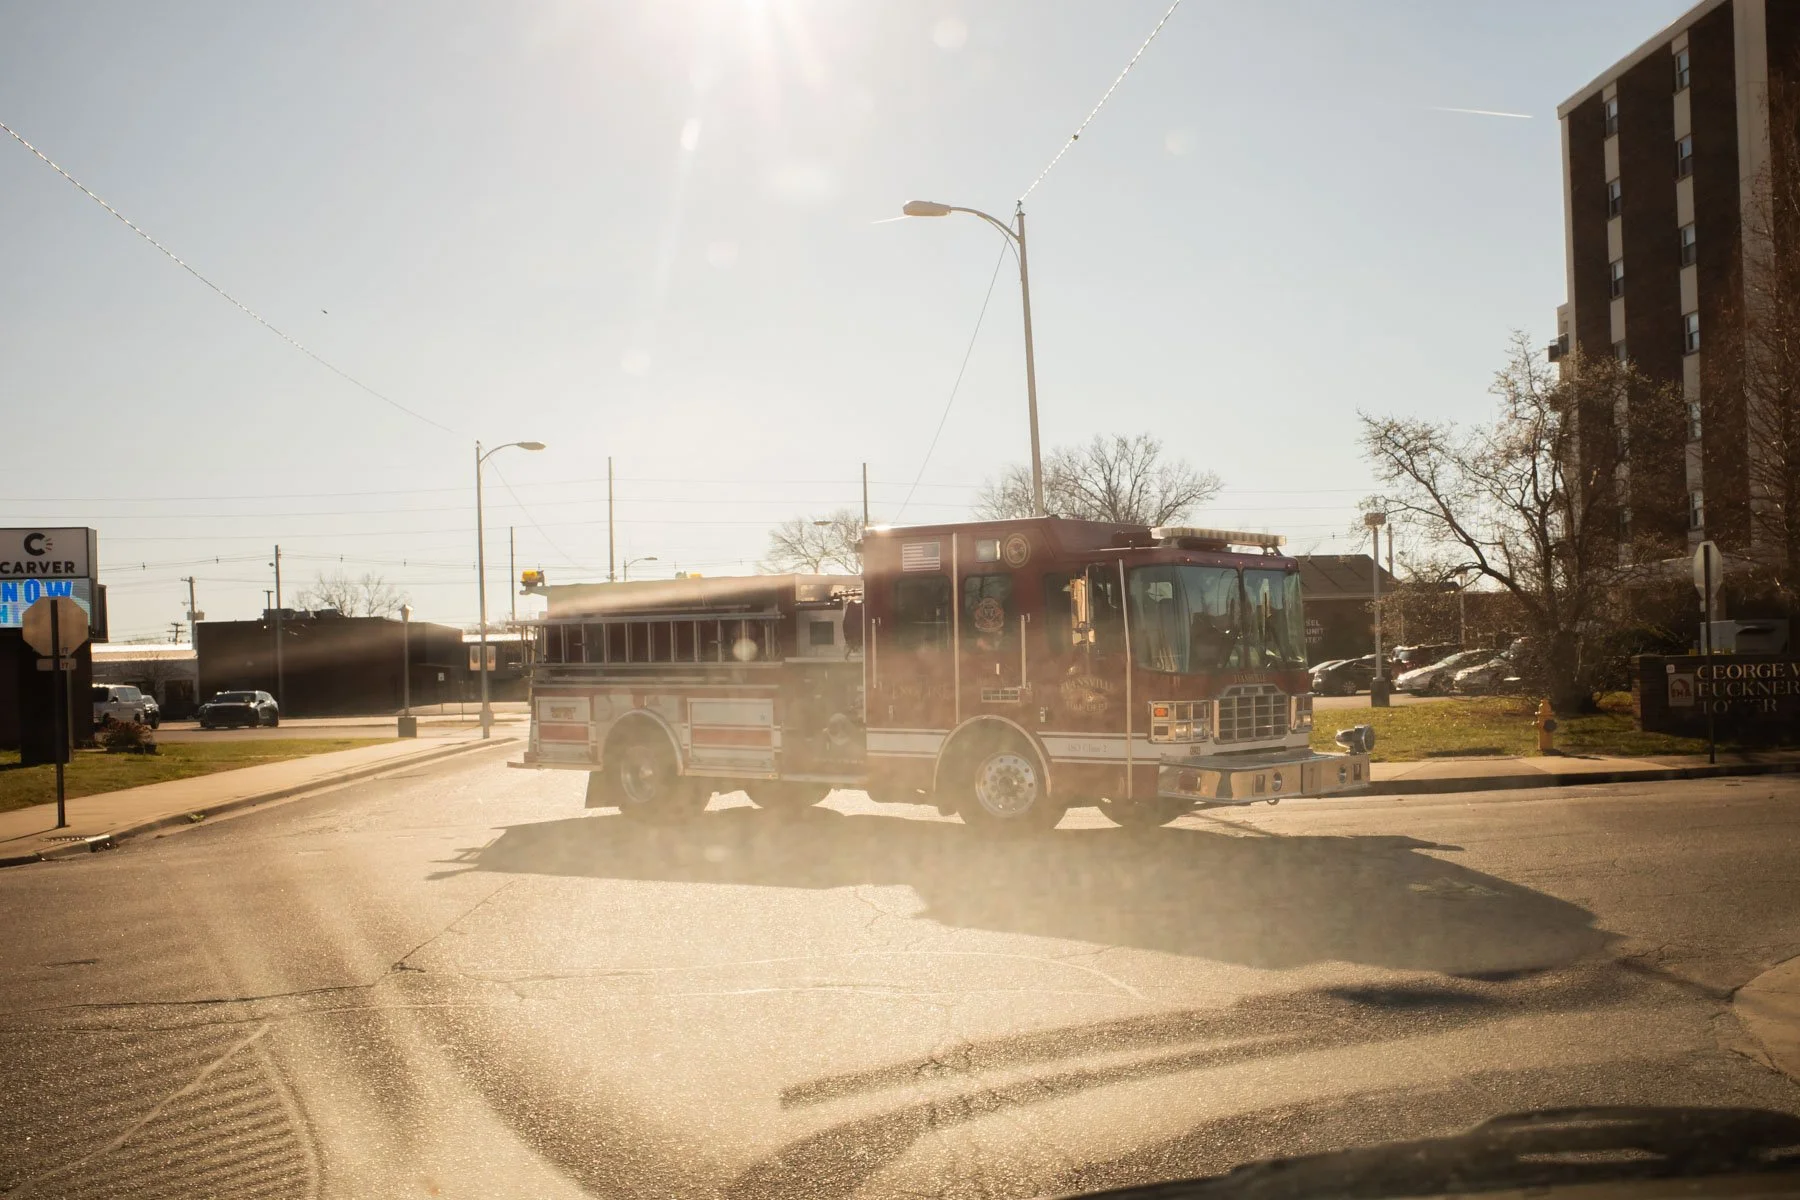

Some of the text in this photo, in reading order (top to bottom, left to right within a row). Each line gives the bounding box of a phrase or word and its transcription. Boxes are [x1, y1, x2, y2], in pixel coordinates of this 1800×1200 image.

[0, 561, 75, 574] CARVER
[1, 578, 73, 604] NOW
[1696, 662, 1786, 680] GEORGE
